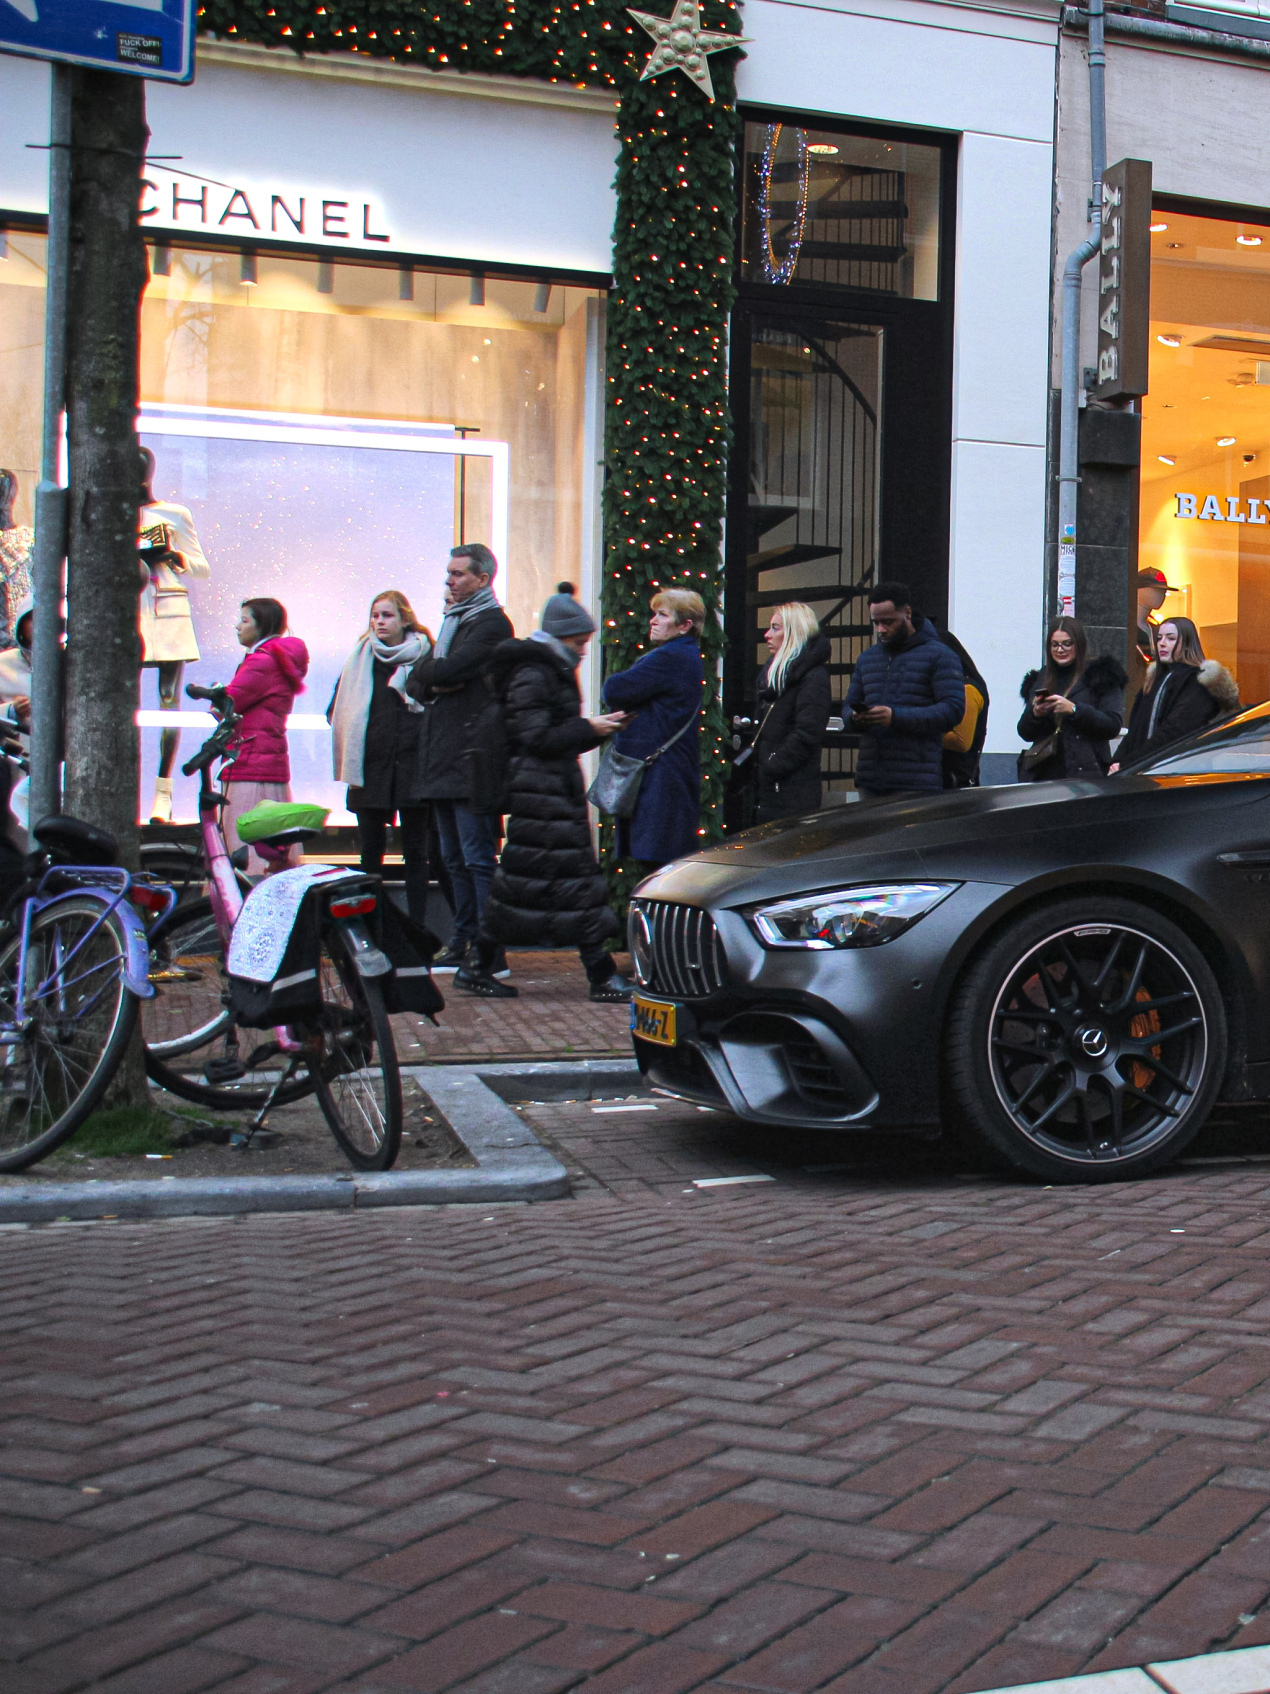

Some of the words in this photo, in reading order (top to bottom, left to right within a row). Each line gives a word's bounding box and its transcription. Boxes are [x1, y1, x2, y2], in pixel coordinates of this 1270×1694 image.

[120, 39, 141, 47] FUCK
[120, 49, 160, 63] WELCOME!
[141, 177, 391, 244] CHANEL
[1099, 182, 1121, 386] BALLY
